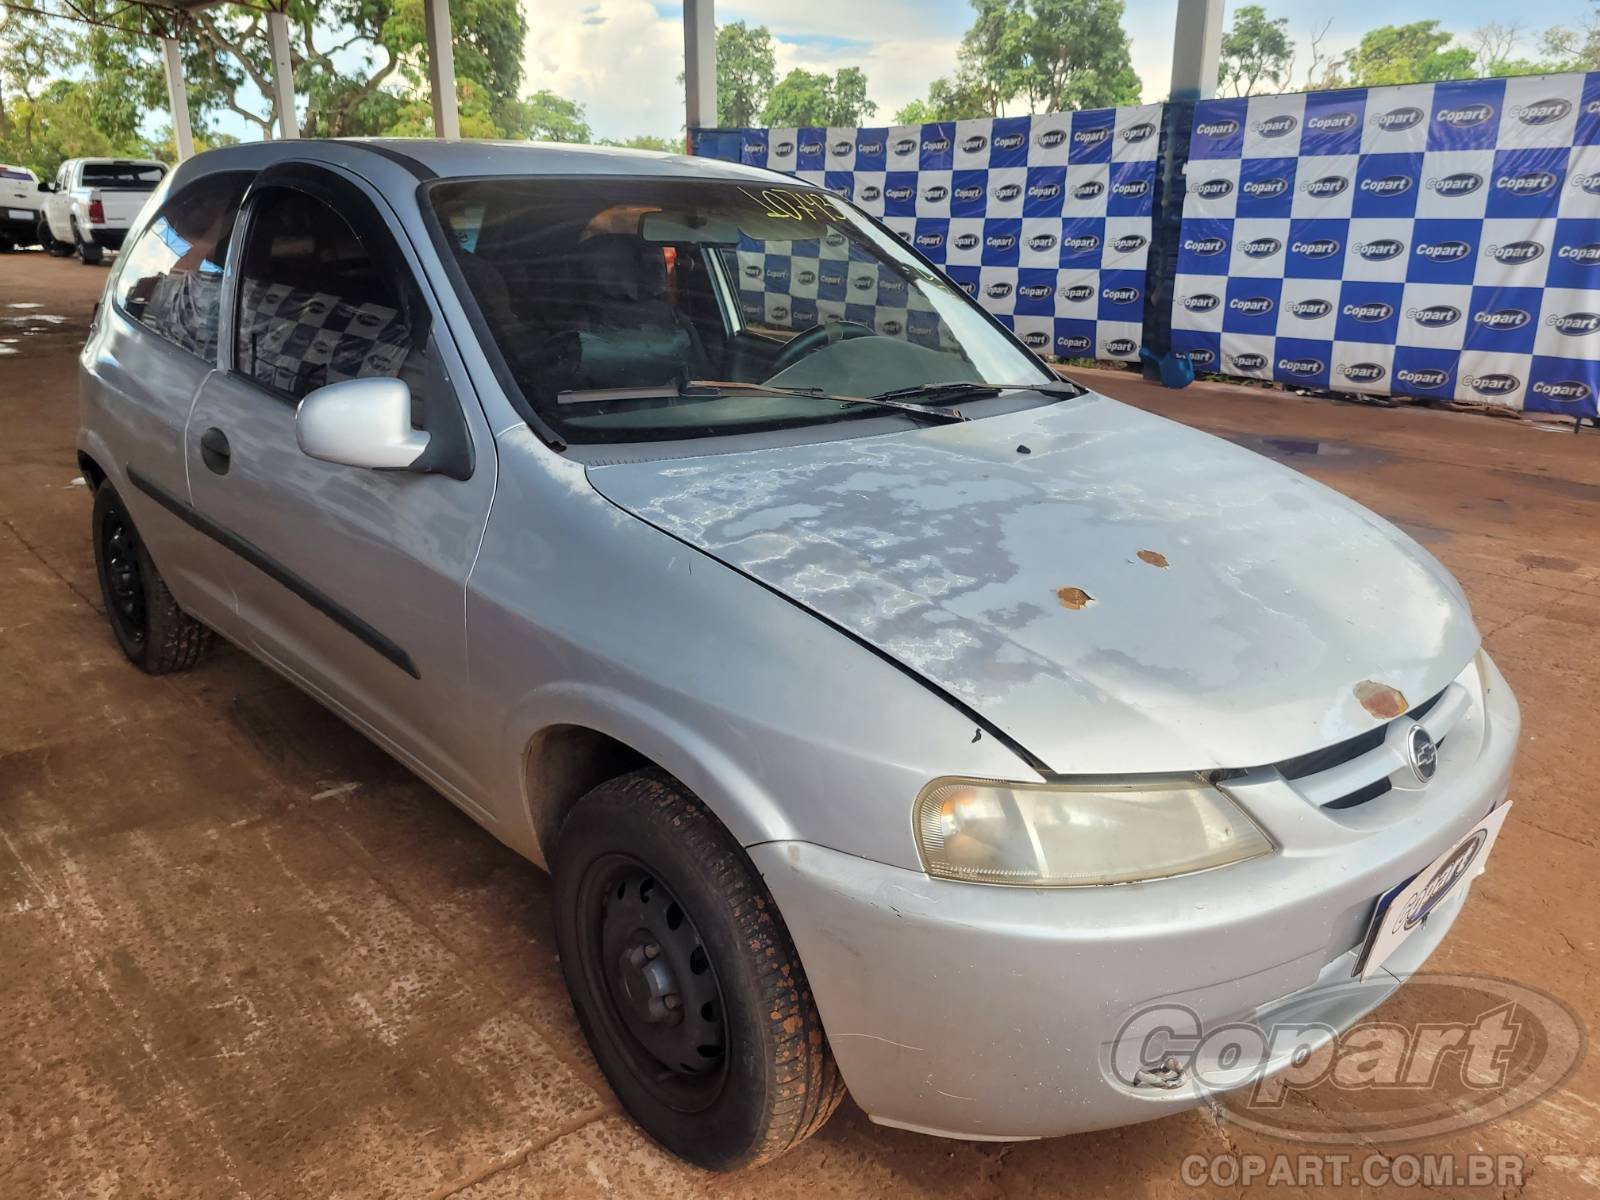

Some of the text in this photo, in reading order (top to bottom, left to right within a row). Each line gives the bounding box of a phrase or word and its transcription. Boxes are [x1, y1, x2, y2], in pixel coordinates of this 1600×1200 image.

[1436, 106, 1486, 123] Copart
[1509, 103, 1562, 119] Copart
[1196, 122, 1235, 136] Copart
[1308, 116, 1352, 130] Copart
[994, 137, 1021, 149] Copart
[1074, 131, 1105, 145] Copart
[1112, 182, 1146, 196] Copart
[1190, 182, 1228, 194] Copart
[1243, 181, 1284, 194] Copart
[1300, 179, 1342, 194] Copart
[1360, 178, 1406, 193] Copart
[1425, 177, 1476, 192] Copart
[1496, 174, 1550, 191] Copart
[1571, 175, 1600, 191] Cop
[954, 188, 979, 199] Copart
[1028, 186, 1056, 198] Copart
[916, 235, 941, 246] Copart
[987, 235, 1013, 247] Copart
[1064, 237, 1095, 249] Copart
[1184, 240, 1221, 252] Copart
[1237, 240, 1277, 254] Copart
[1291, 241, 1335, 255] Copart
[1351, 242, 1397, 256] Copart
[1416, 243, 1465, 258] Copart
[1485, 243, 1537, 259] Copart
[1558, 245, 1600, 260] Copar
[1019, 286, 1048, 298] Copart
[1102, 289, 1135, 302] Copart
[1230, 298, 1269, 311] Copart
[1286, 302, 1326, 315] Copart
[1343, 304, 1387, 318] Copart
[1406, 307, 1455, 322] Copart
[1474, 311, 1524, 326] Copart
[1545, 313, 1598, 330] Copart
[1057, 337, 1087, 349] Copart
[1278, 359, 1319, 372] Copart
[1336, 364, 1379, 378] Copart
[1397, 369, 1443, 385] Copart
[1463, 375, 1513, 390] Copart
[1532, 381, 1584, 397] Copart
